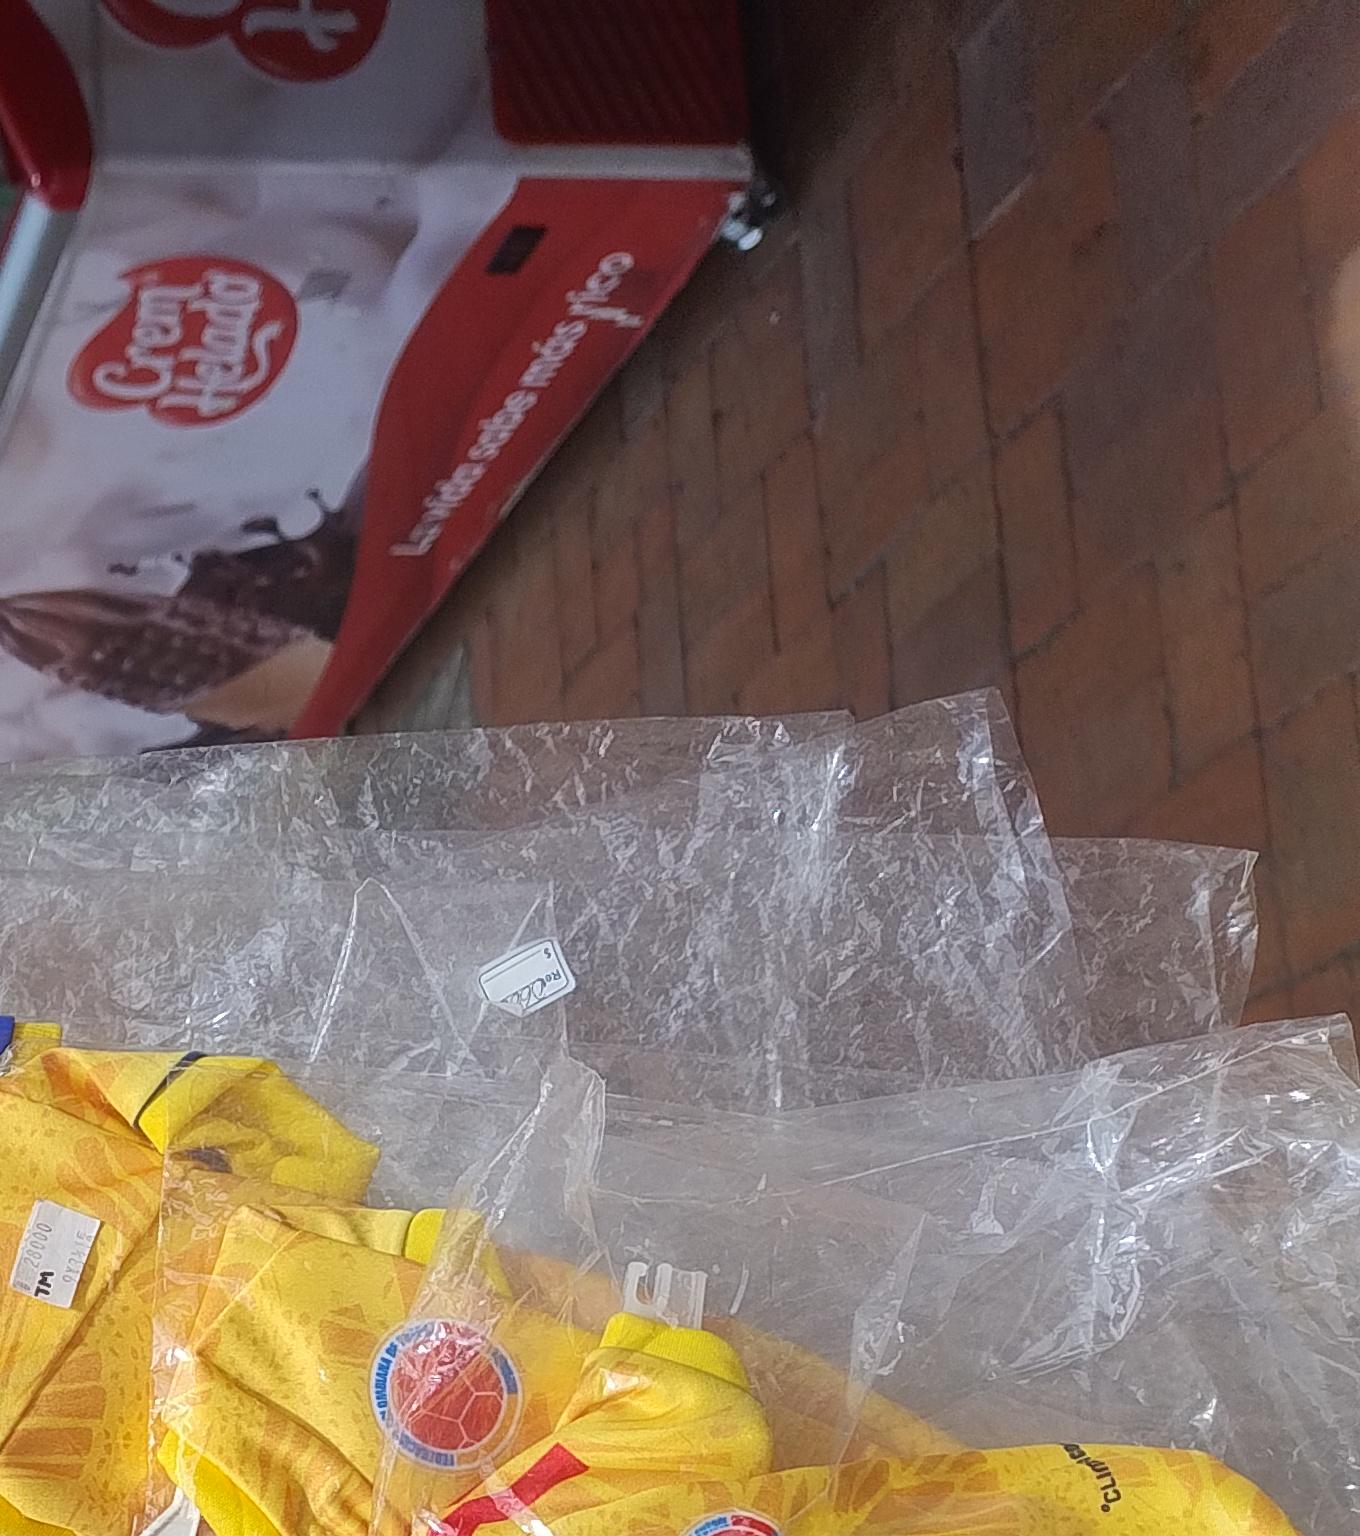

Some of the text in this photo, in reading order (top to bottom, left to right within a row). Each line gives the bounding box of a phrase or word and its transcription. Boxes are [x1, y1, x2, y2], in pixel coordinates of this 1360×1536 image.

[91, 282, 204, 400] Crem
[156, 268, 280, 418] Helado
[422, 461, 488, 522] vida
[467, 388, 538, 462] sabe
[23, 1222, 53, 1269] 28000
[33, 1271, 55, 1297] TM
